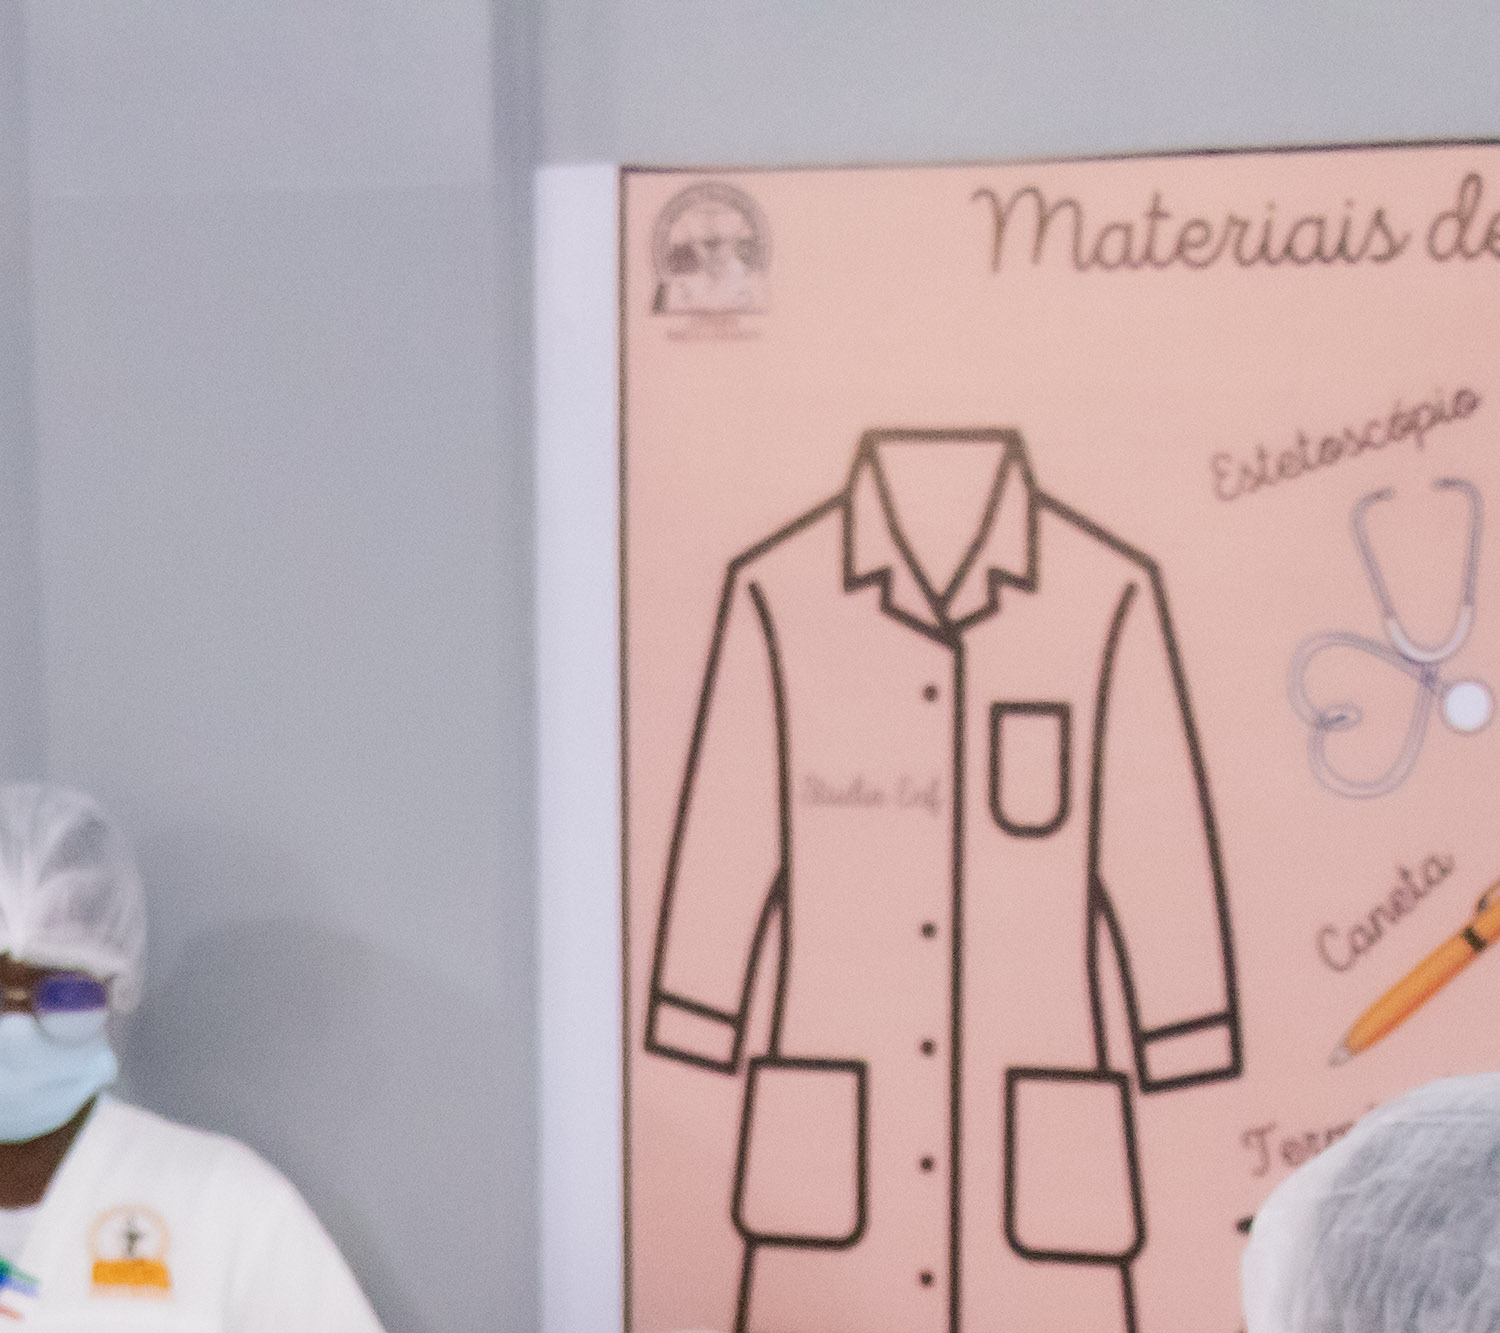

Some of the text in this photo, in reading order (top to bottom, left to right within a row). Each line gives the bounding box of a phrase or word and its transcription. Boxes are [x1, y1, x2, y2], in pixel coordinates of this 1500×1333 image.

[973, 185, 1409, 274] Materiais
[1209, 388, 1482, 501] Estetoscópio
[1316, 855, 1455, 972] Caneta
